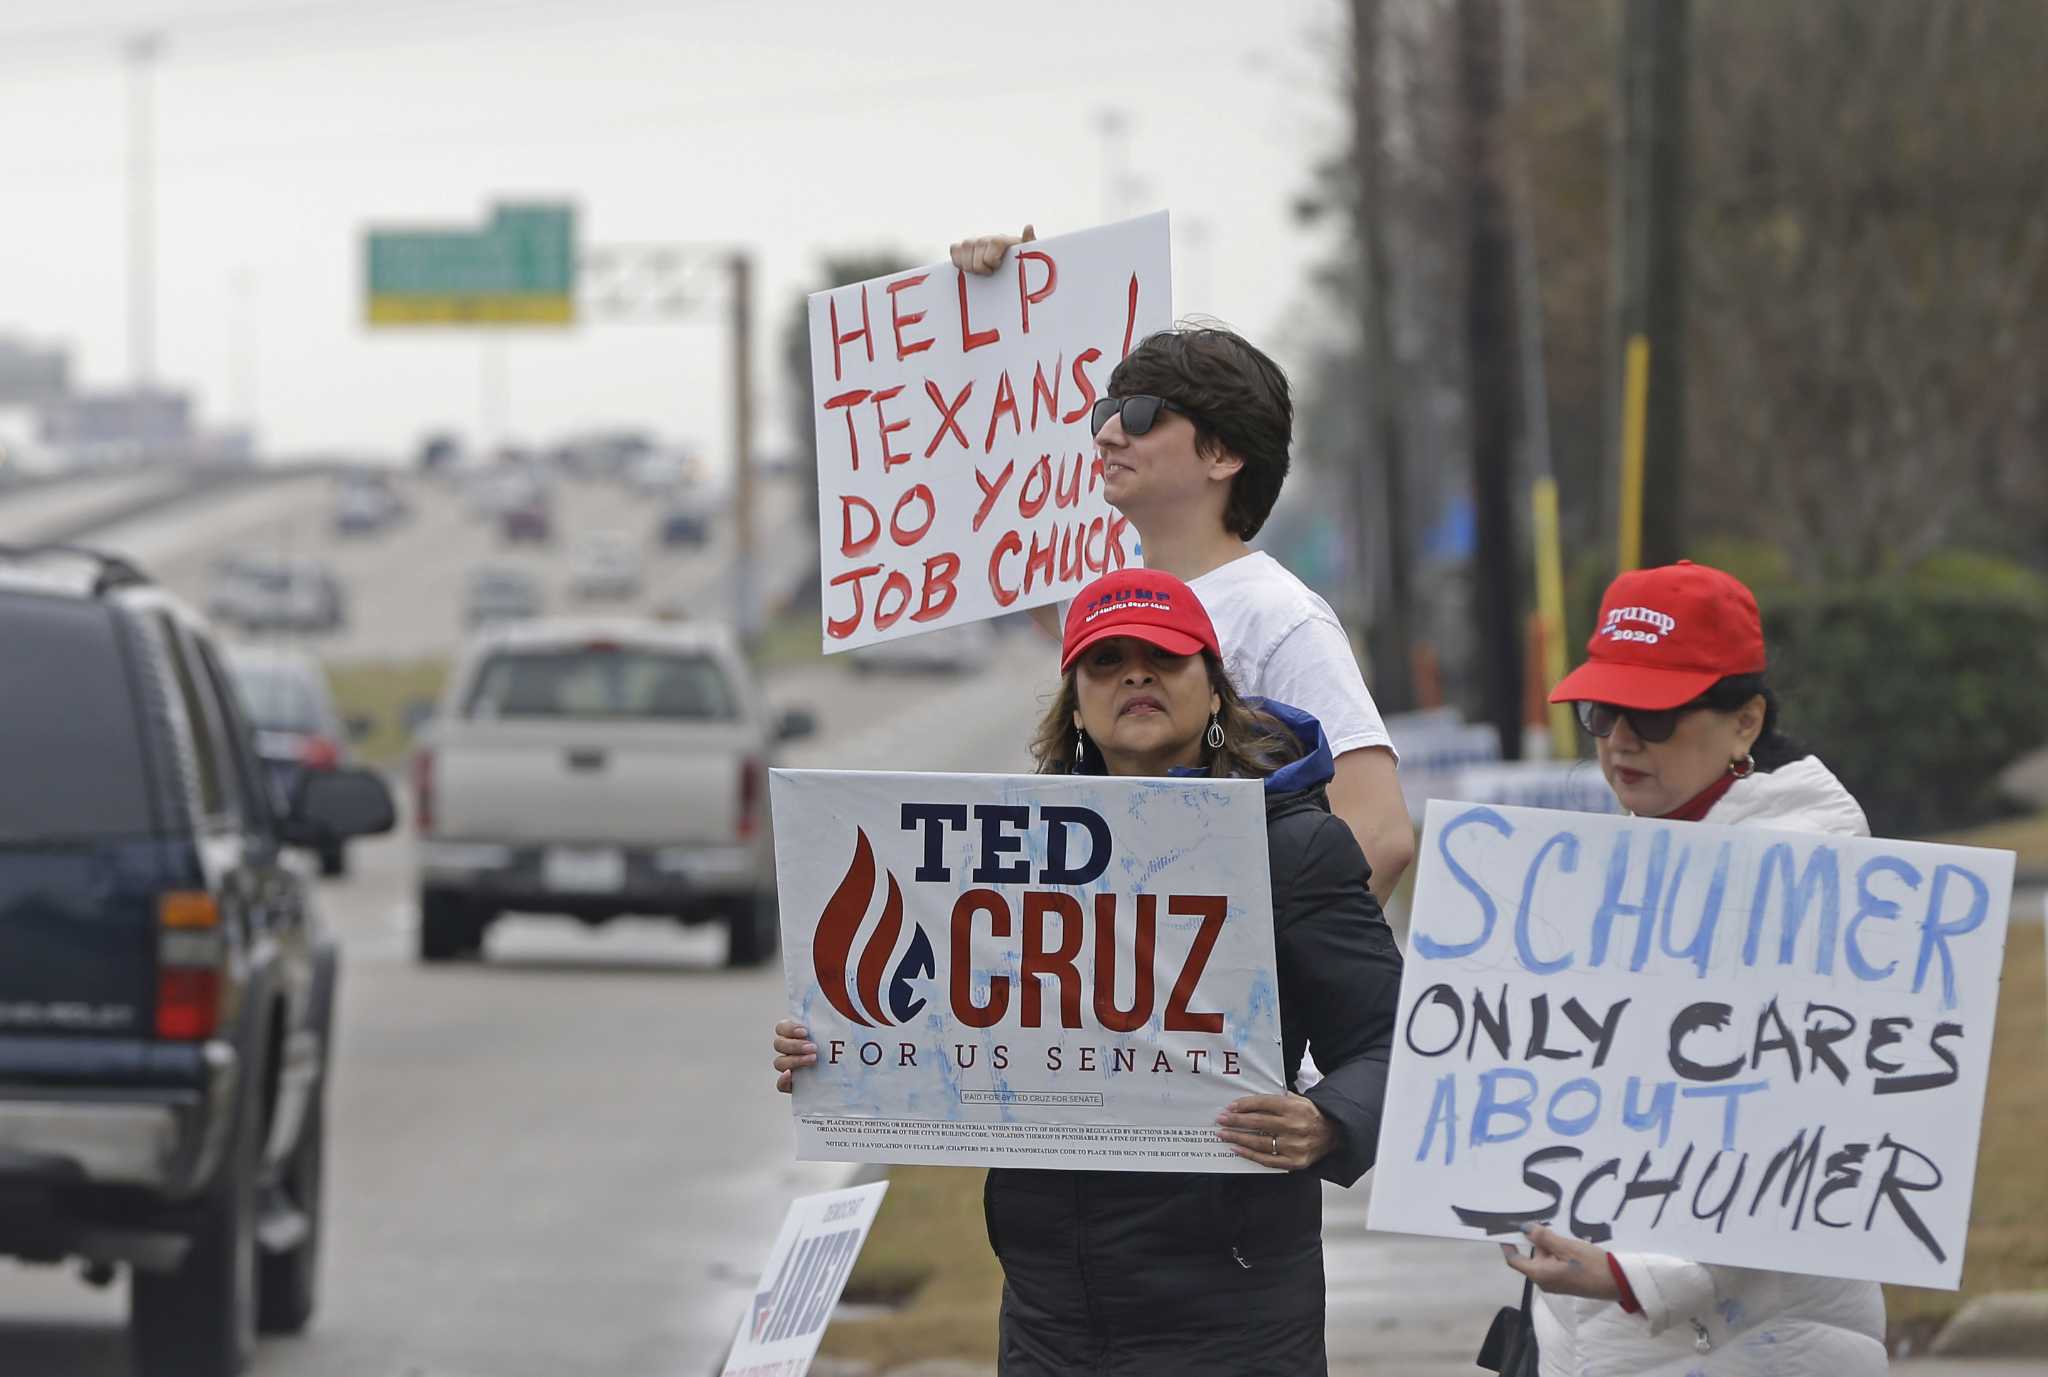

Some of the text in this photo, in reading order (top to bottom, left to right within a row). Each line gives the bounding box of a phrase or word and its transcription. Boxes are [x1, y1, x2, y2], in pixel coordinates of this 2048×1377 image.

[829, 249, 1058, 382] HELP
[837, 483, 937, 559] DO
[826, 507, 1130, 640] JOB CHUCK
[1087, 587, 1170, 611] TRUMP
[1605, 606, 1675, 636] Trump
[1611, 629, 1659, 644] 2020
[900, 802, 1113, 886] TED
[1412, 805, 1990, 1011] SCHUMER
[949, 888, 1229, 1034] CRUZ
[828, 1040, 1242, 1076] FOR US SENATE
[1405, 983, 1966, 1095] ONLY CARES
[964, 1093, 982, 1101] PAID
[1001, 1094, 1011, 1102] BY
[1013, 1094, 1028, 1102] TED
[1029, 1095, 1051, 1103] CRUZ
[1052, 1095, 1068, 1103] FOR
[1069, 1096, 1100, 1104] SENATE
[1416, 1066, 1770, 1167] ABOUT
[1451, 1125, 1948, 1264] SCHUMER
